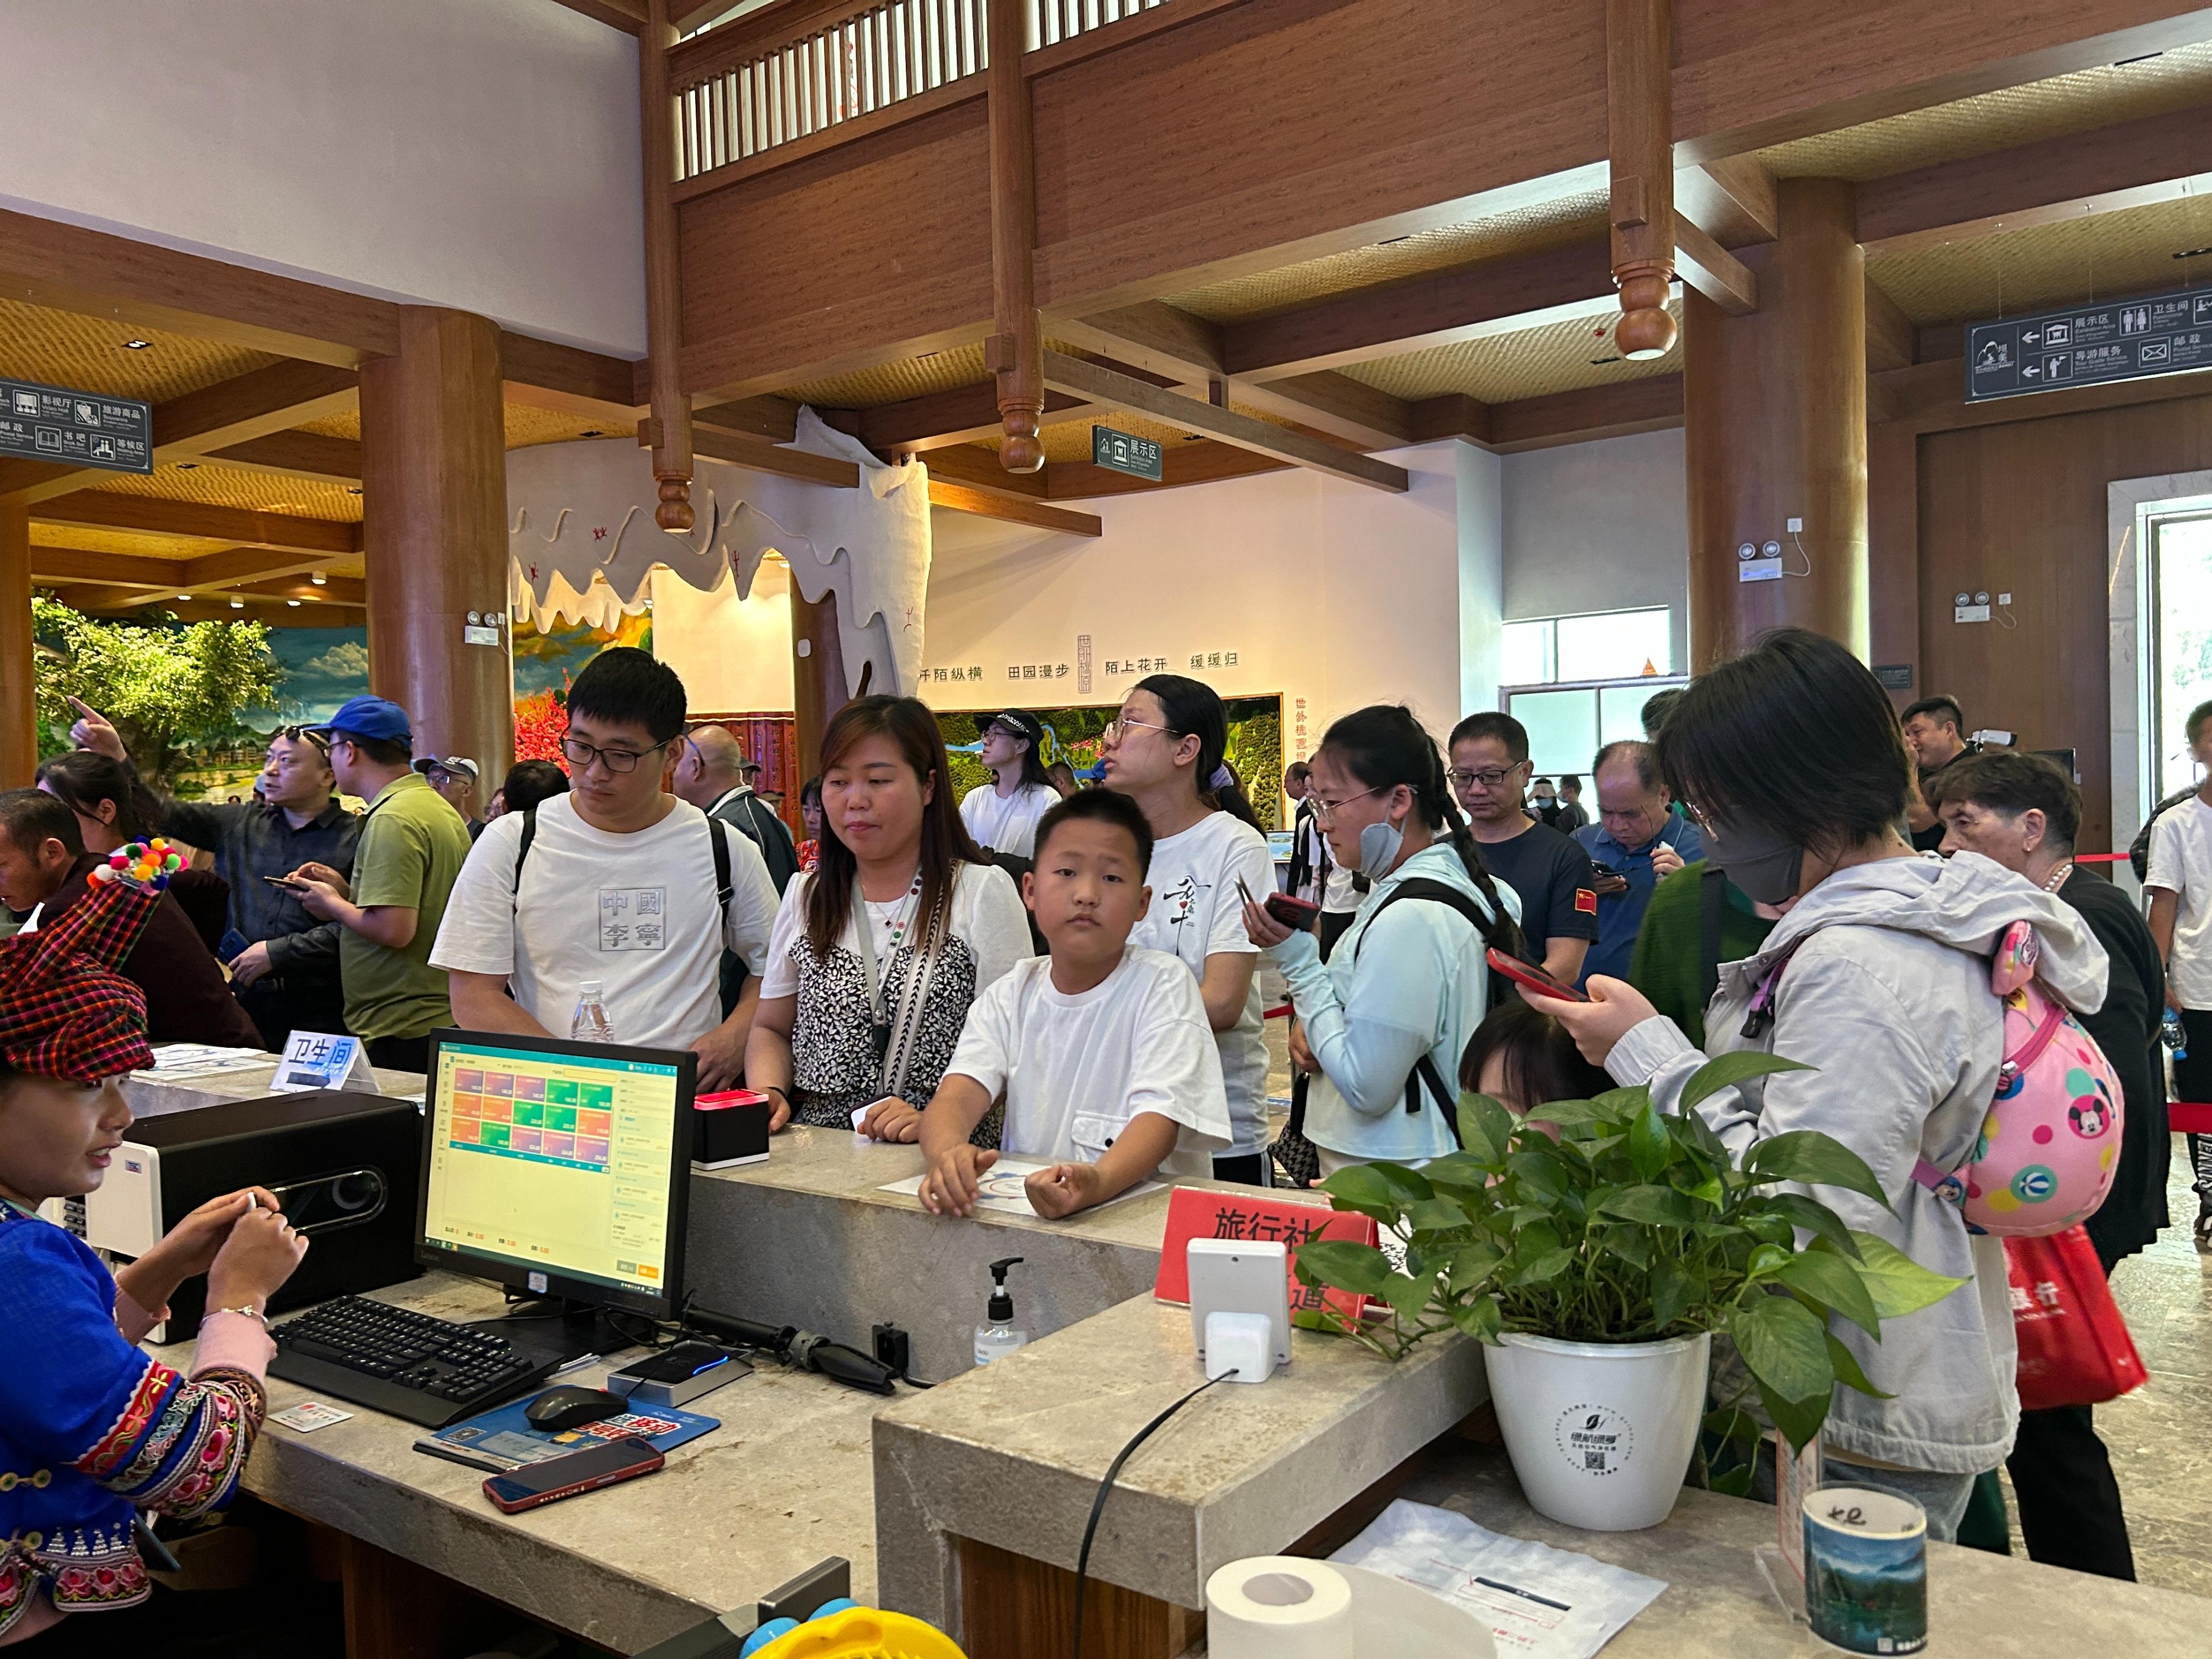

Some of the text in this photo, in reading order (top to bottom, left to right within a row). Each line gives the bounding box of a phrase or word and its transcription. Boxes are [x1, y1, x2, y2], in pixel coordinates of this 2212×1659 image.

[2153, 300, 2188, 315] 卫生间
[2075, 314, 2109, 328] 展示区
[2174, 333, 2201, 346] 邮政
[2075, 346, 2122, 361] 导游服务
[41, 395, 72, 409] 影视厅
[103, 405, 141, 419] 旅游商品
[0, 421, 23, 433] 邮政
[117, 438, 145, 451] 等候区
[1130, 440, 1157, 460] 展示区
[1106, 652, 1238, 674] 陌上花开 缓缓归
[1009, 663, 1069, 679] 田园漫步
[603, 891, 660, 916] 中國
[602, 924, 661, 947] 李寧
[288, 1038, 353, 1069] 卫生间
